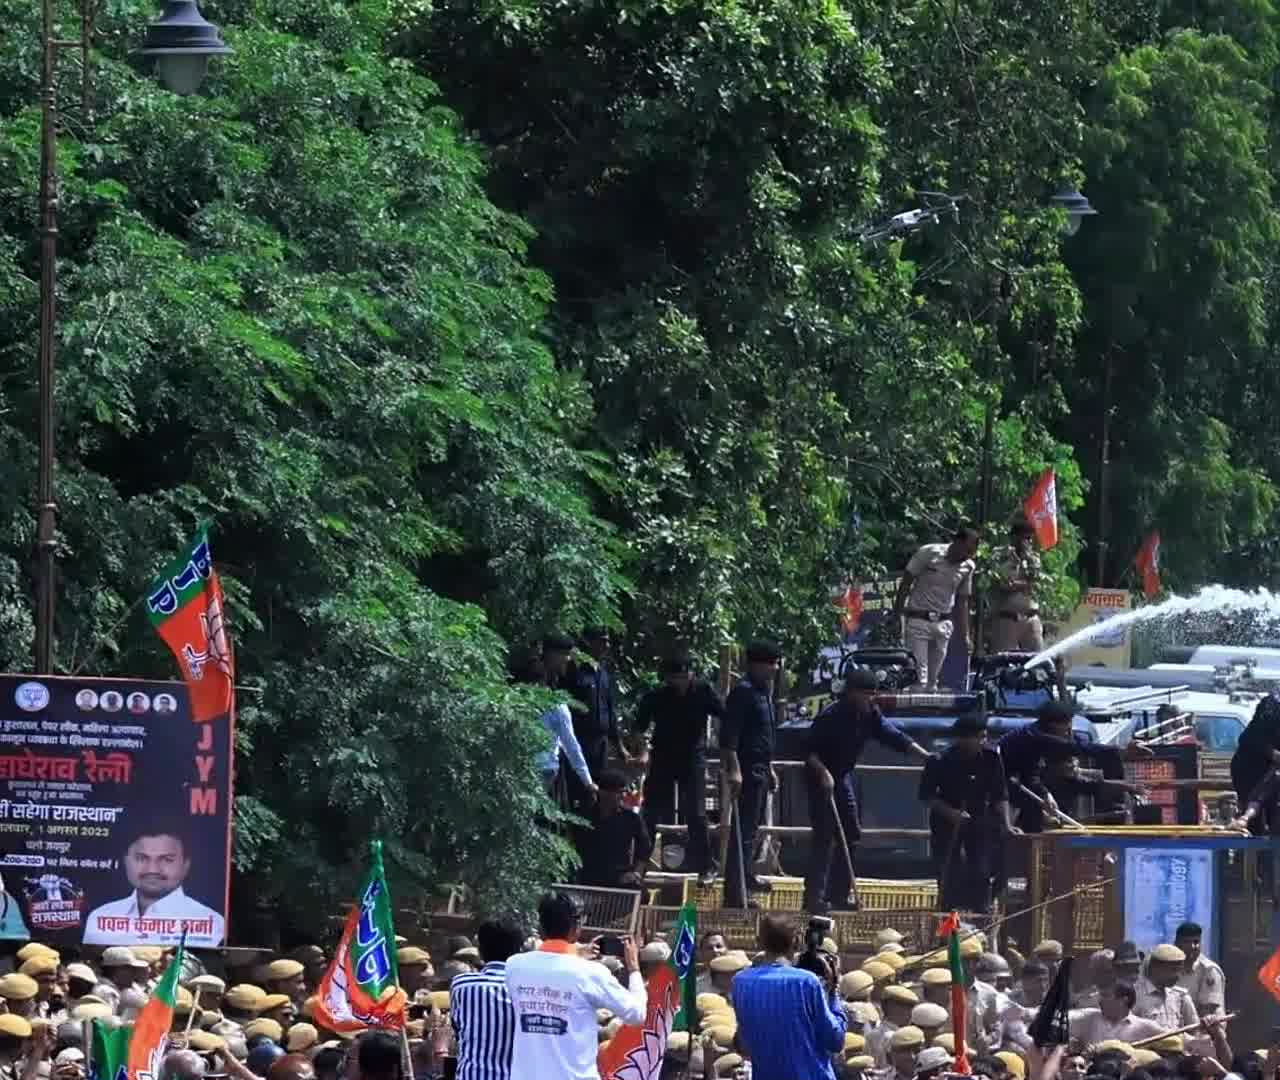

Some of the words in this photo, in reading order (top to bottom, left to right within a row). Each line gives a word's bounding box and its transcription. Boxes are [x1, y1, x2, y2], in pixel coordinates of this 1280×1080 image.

[81, 749, 132, 784] रैली
[12, 800, 49, 820] सहेगा
[80, 827, 110, 837] 2023
